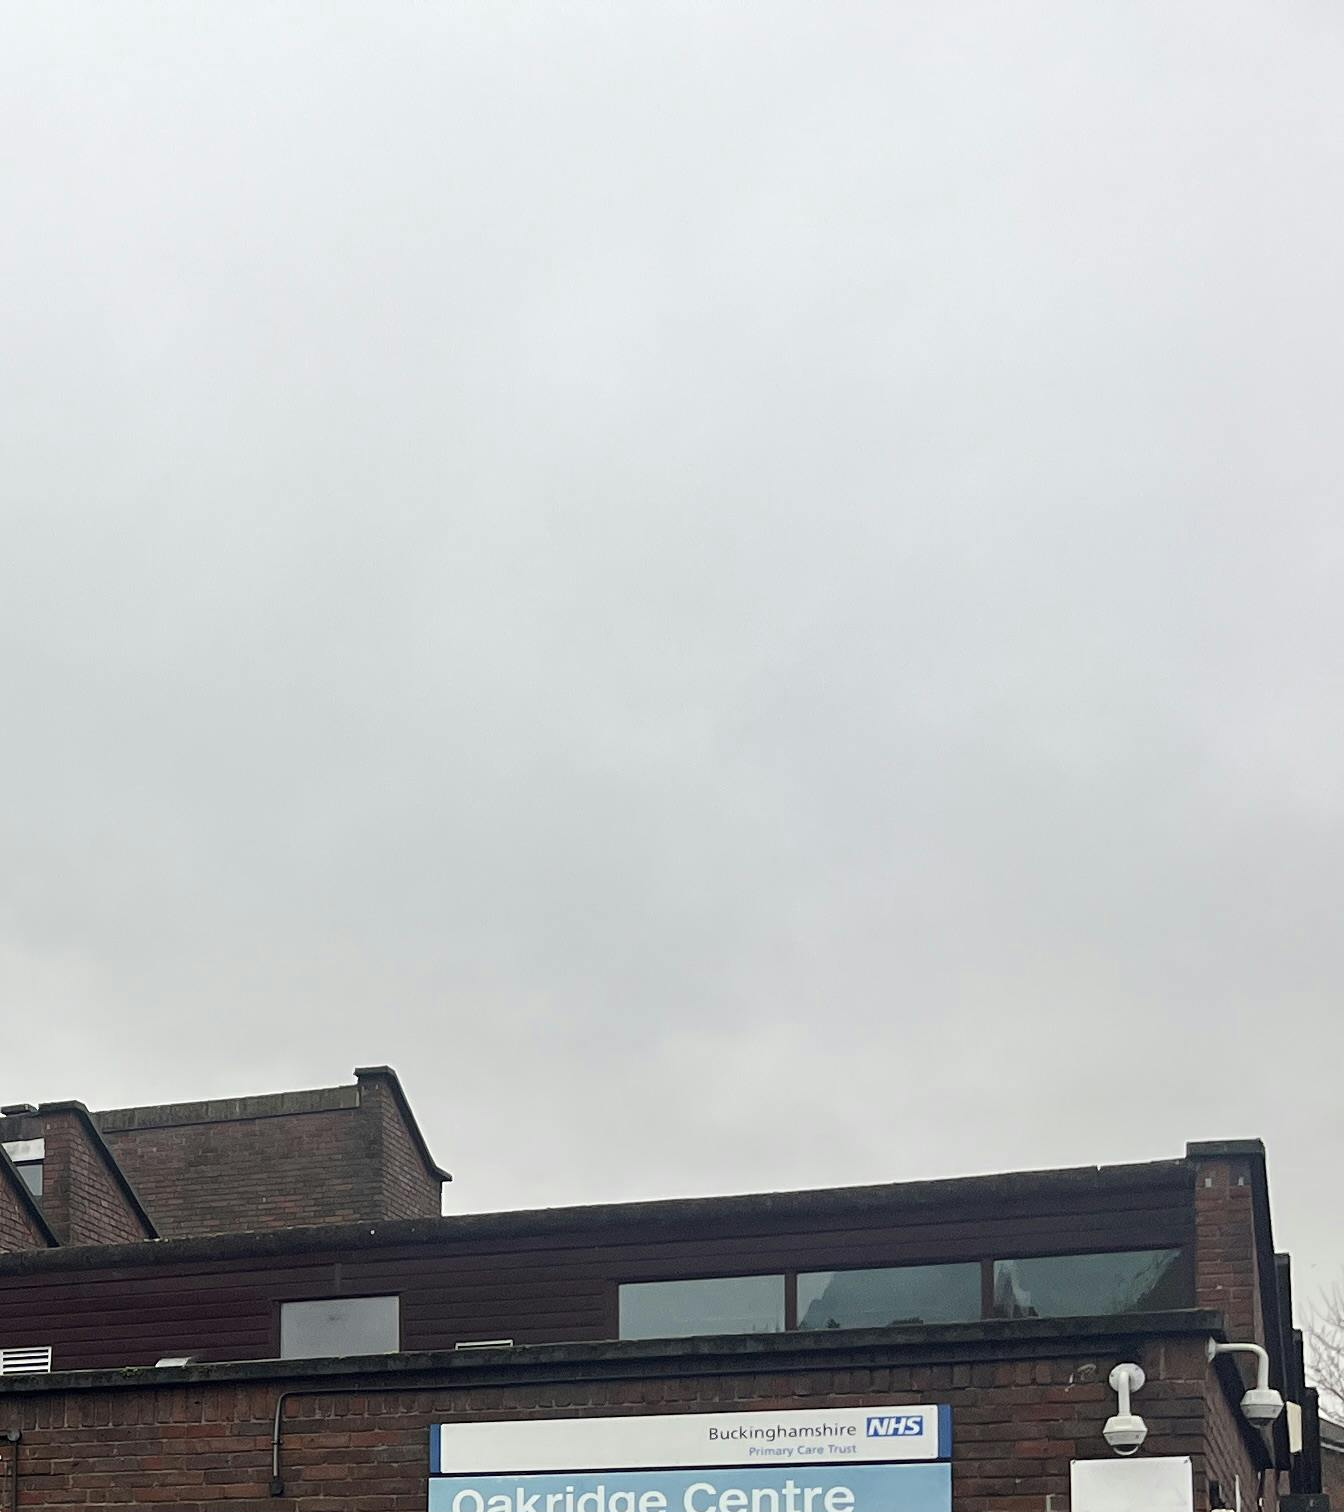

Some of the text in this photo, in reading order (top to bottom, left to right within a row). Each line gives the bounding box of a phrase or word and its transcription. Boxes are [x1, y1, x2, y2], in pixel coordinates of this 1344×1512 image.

[709, 1416, 923, 1442] Buckinghamshire NHS
[749, 1444, 857, 1457] Primary Care Trust
